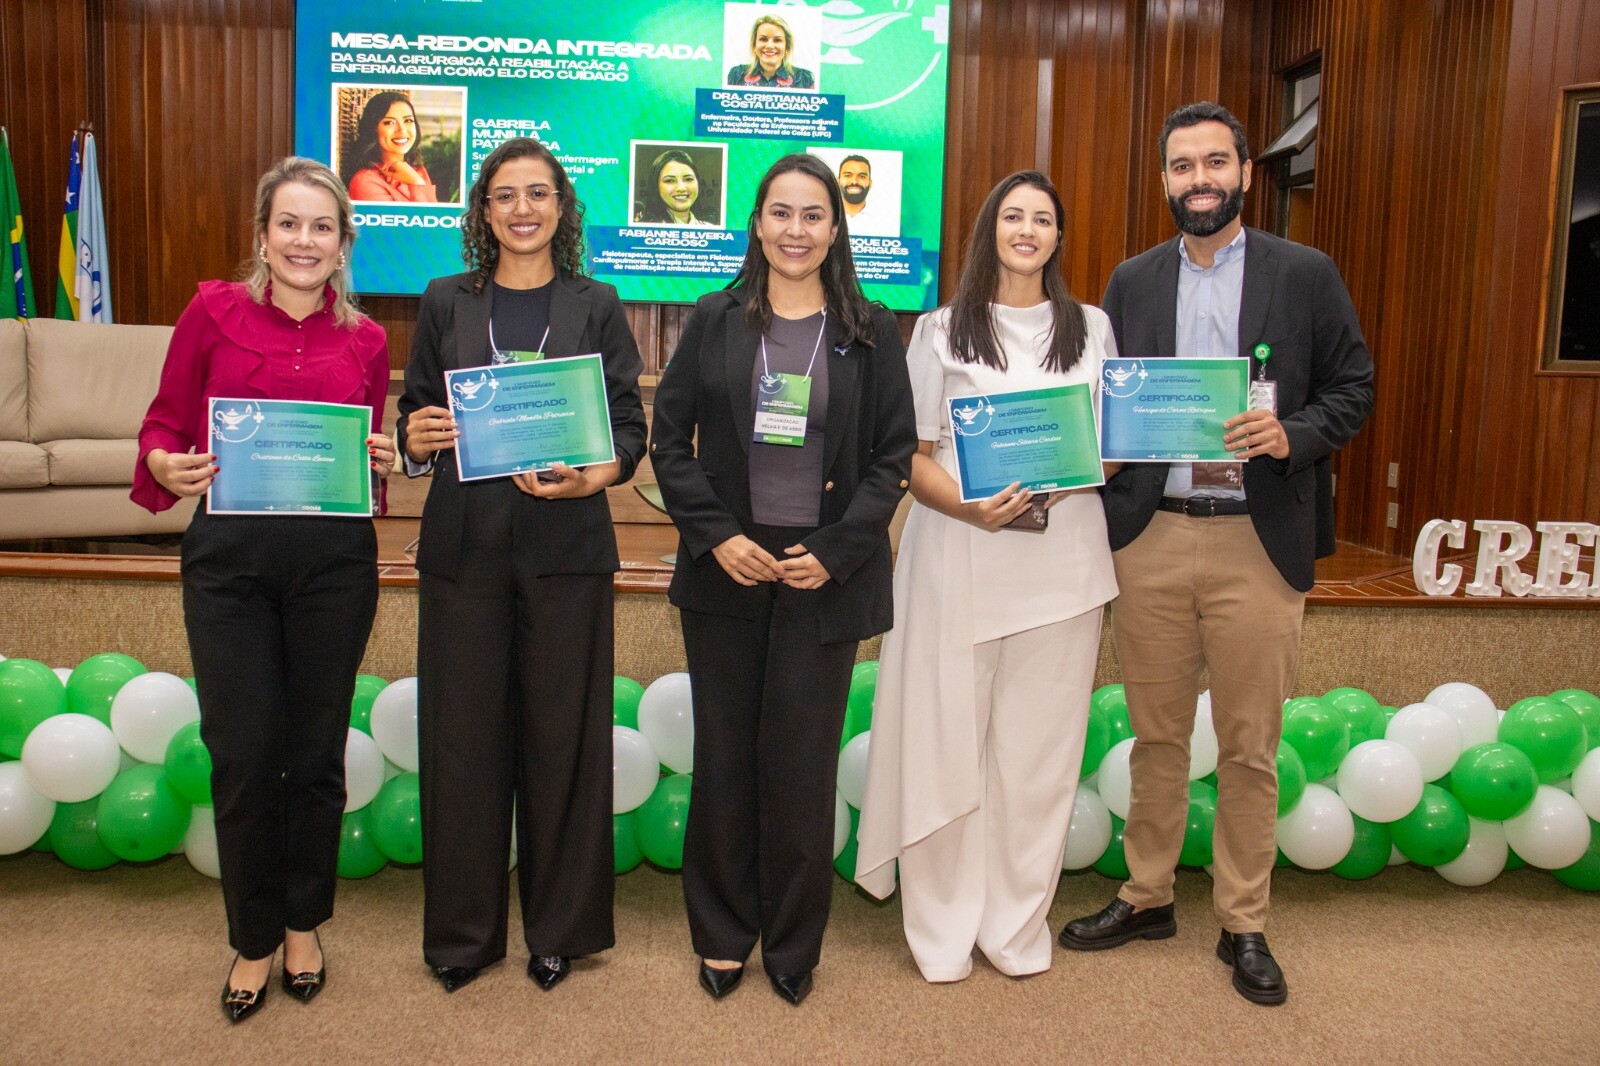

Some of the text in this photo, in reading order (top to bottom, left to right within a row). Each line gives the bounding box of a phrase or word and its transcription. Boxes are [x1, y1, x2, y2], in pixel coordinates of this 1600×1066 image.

[332, 32, 712, 61] MESA-REDONDA INTEGRADA
[332, 52, 630, 72] DA SALA CIRÚRGICA À REABILITAÇÃO: A
[332, 63, 630, 82] ENFERMAGEM COMO ELO DO CUIDADO
[712, 92, 828, 105] DRA. CRISTIANA DA
[720, 100, 820, 112] COSTA LUCIANO
[472, 119, 551, 130] GABRIELA
[700, 114, 742, 122] Enfermeira,
[774, 116, 810, 124] Professora
[812, 118, 838, 127] adjunta
[770, 123, 816, 132] Enfermagem
[472, 129, 540, 140] MUNILLA
[350, 214, 462, 228] ODERADO
[619, 229, 734, 240] FABIANNE SILVEIRA
[644, 238, 708, 248] CARDOSO
[882, 239, 902, 248] DO
[602, 250, 654, 258] Fisioterapeuta,
[592, 257, 650, 265] Cardiopulmonar
[493, 398, 568, 412] CERTIFICADO
[990, 423, 1059, 438] CERTIFICADO
[254, 440, 332, 450] CERTIFICADO
[1413, 519, 1600, 597] CRE
